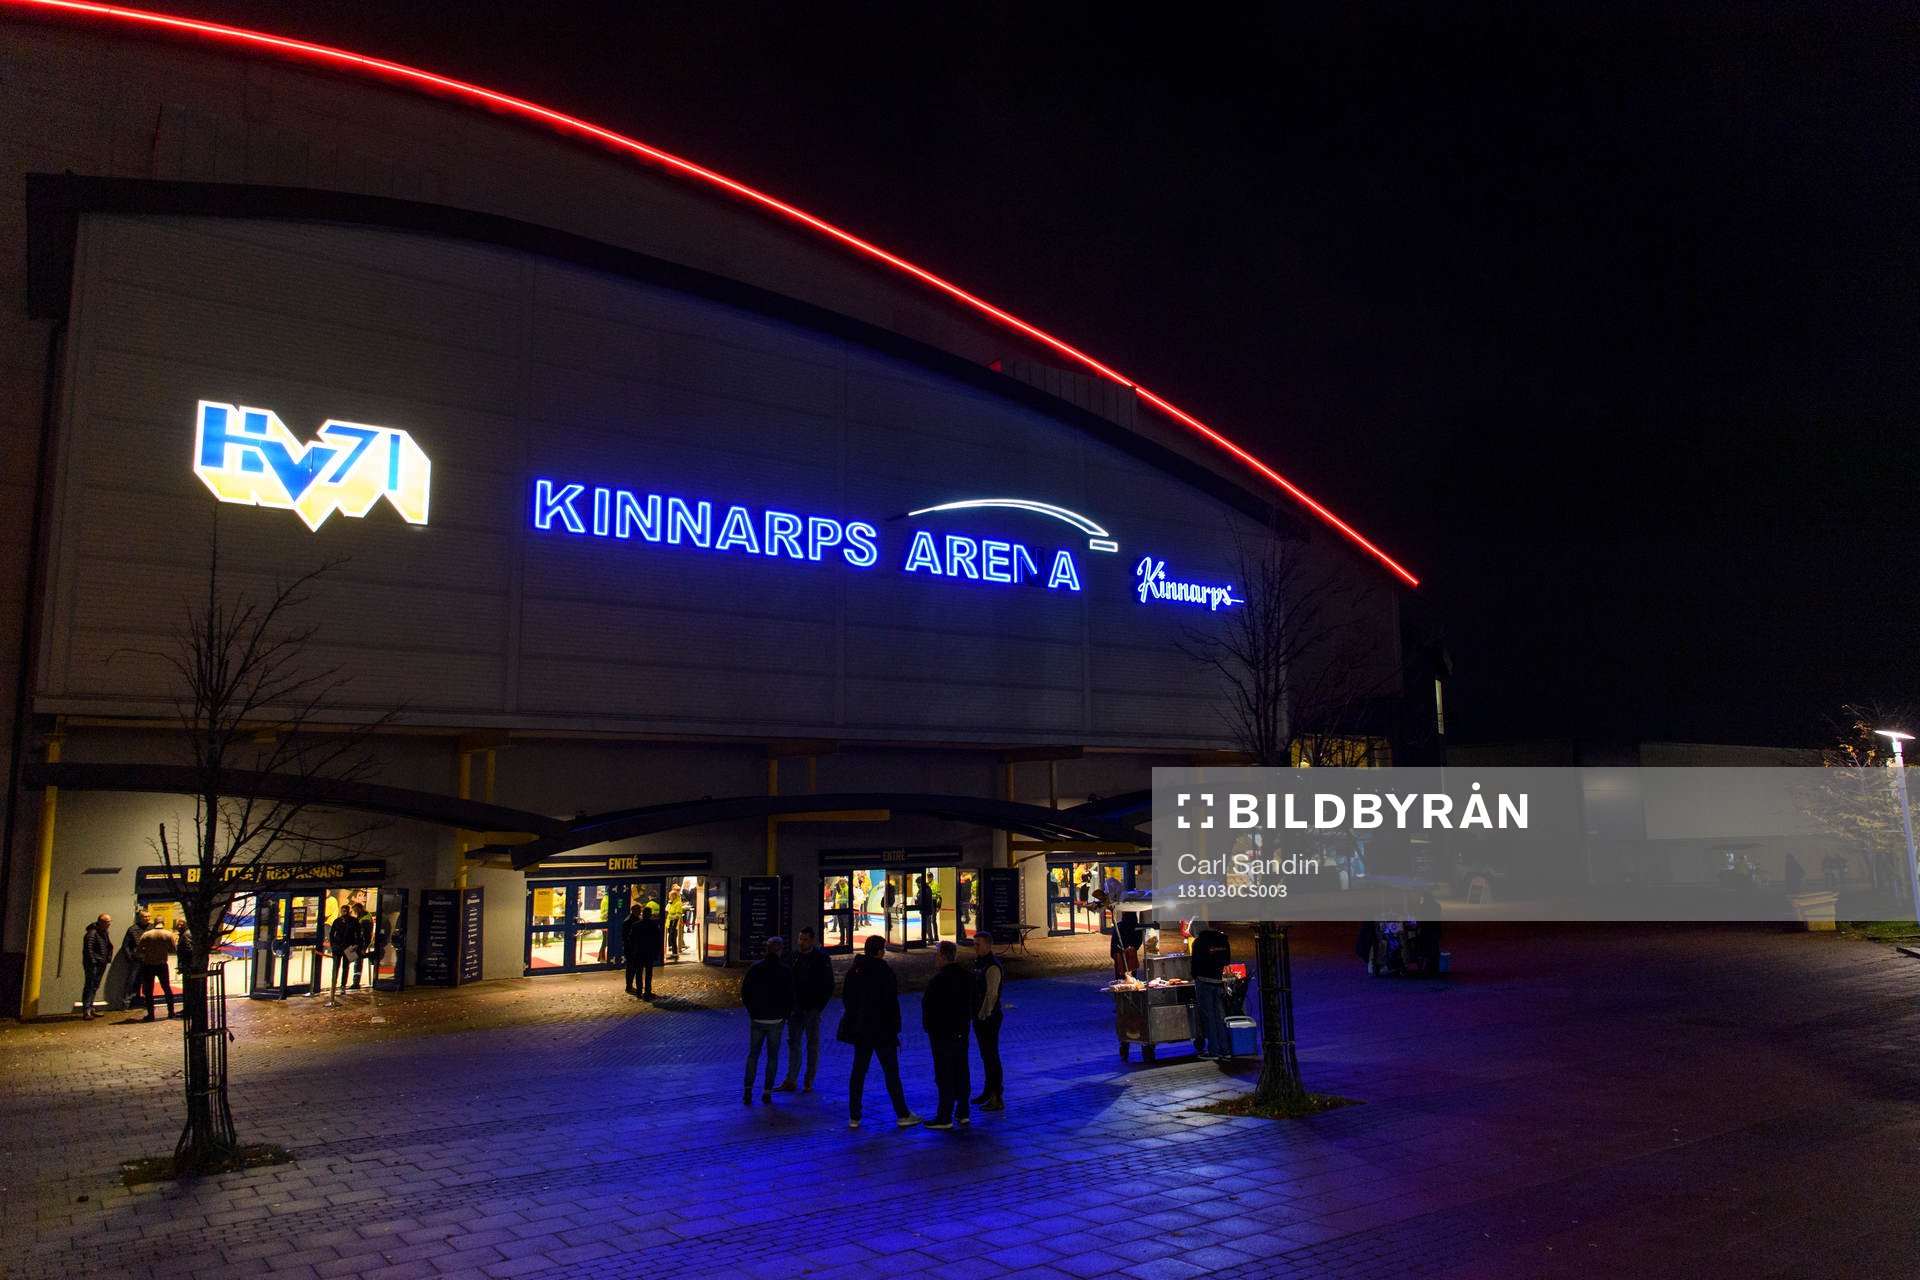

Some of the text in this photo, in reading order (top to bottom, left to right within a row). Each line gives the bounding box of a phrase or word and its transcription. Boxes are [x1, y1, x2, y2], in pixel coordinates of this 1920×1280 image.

[194, 400, 429, 524] HV71
[534, 479, 1081, 591] KINNARPS ARENA
[1137, 556, 1245, 611] Kinnarps
[608, 855, 639, 871] ENTRÉ
